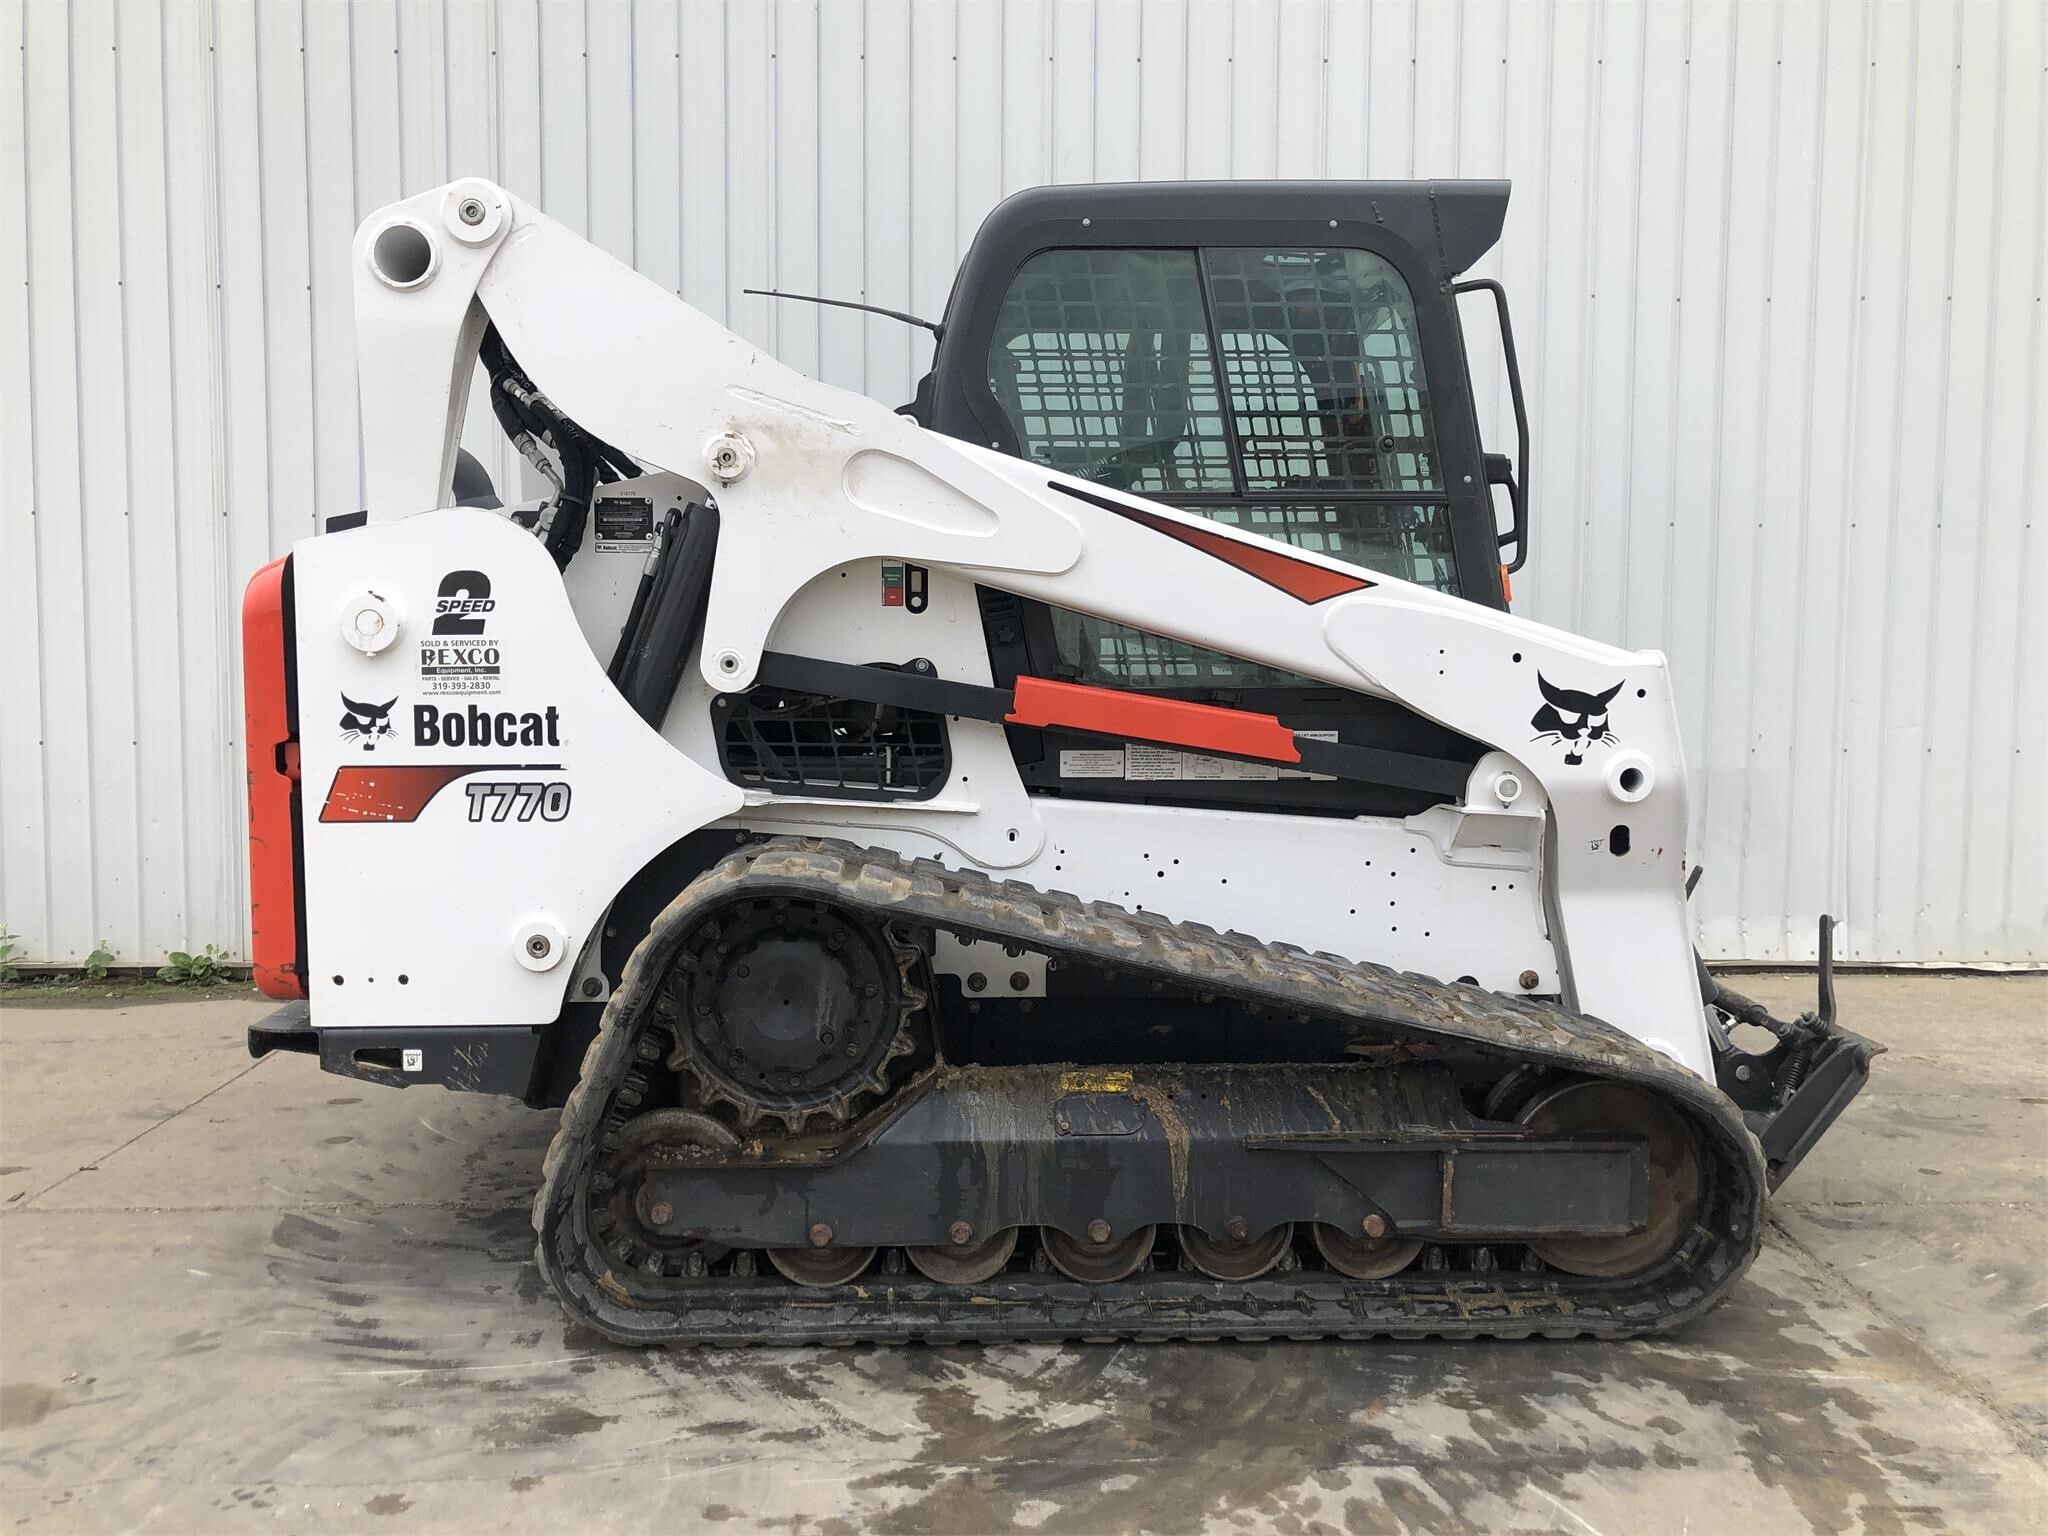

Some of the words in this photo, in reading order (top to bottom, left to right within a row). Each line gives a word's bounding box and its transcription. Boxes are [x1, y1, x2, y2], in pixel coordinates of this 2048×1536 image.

[432, 570, 491, 635] 2
[435, 600, 496, 613] SPEED
[421, 648, 500, 665] REXCO
[432, 682, 491, 690] 319-393-2830
[413, 704, 560, 747] Bobcat
[465, 782, 572, 822] T770
